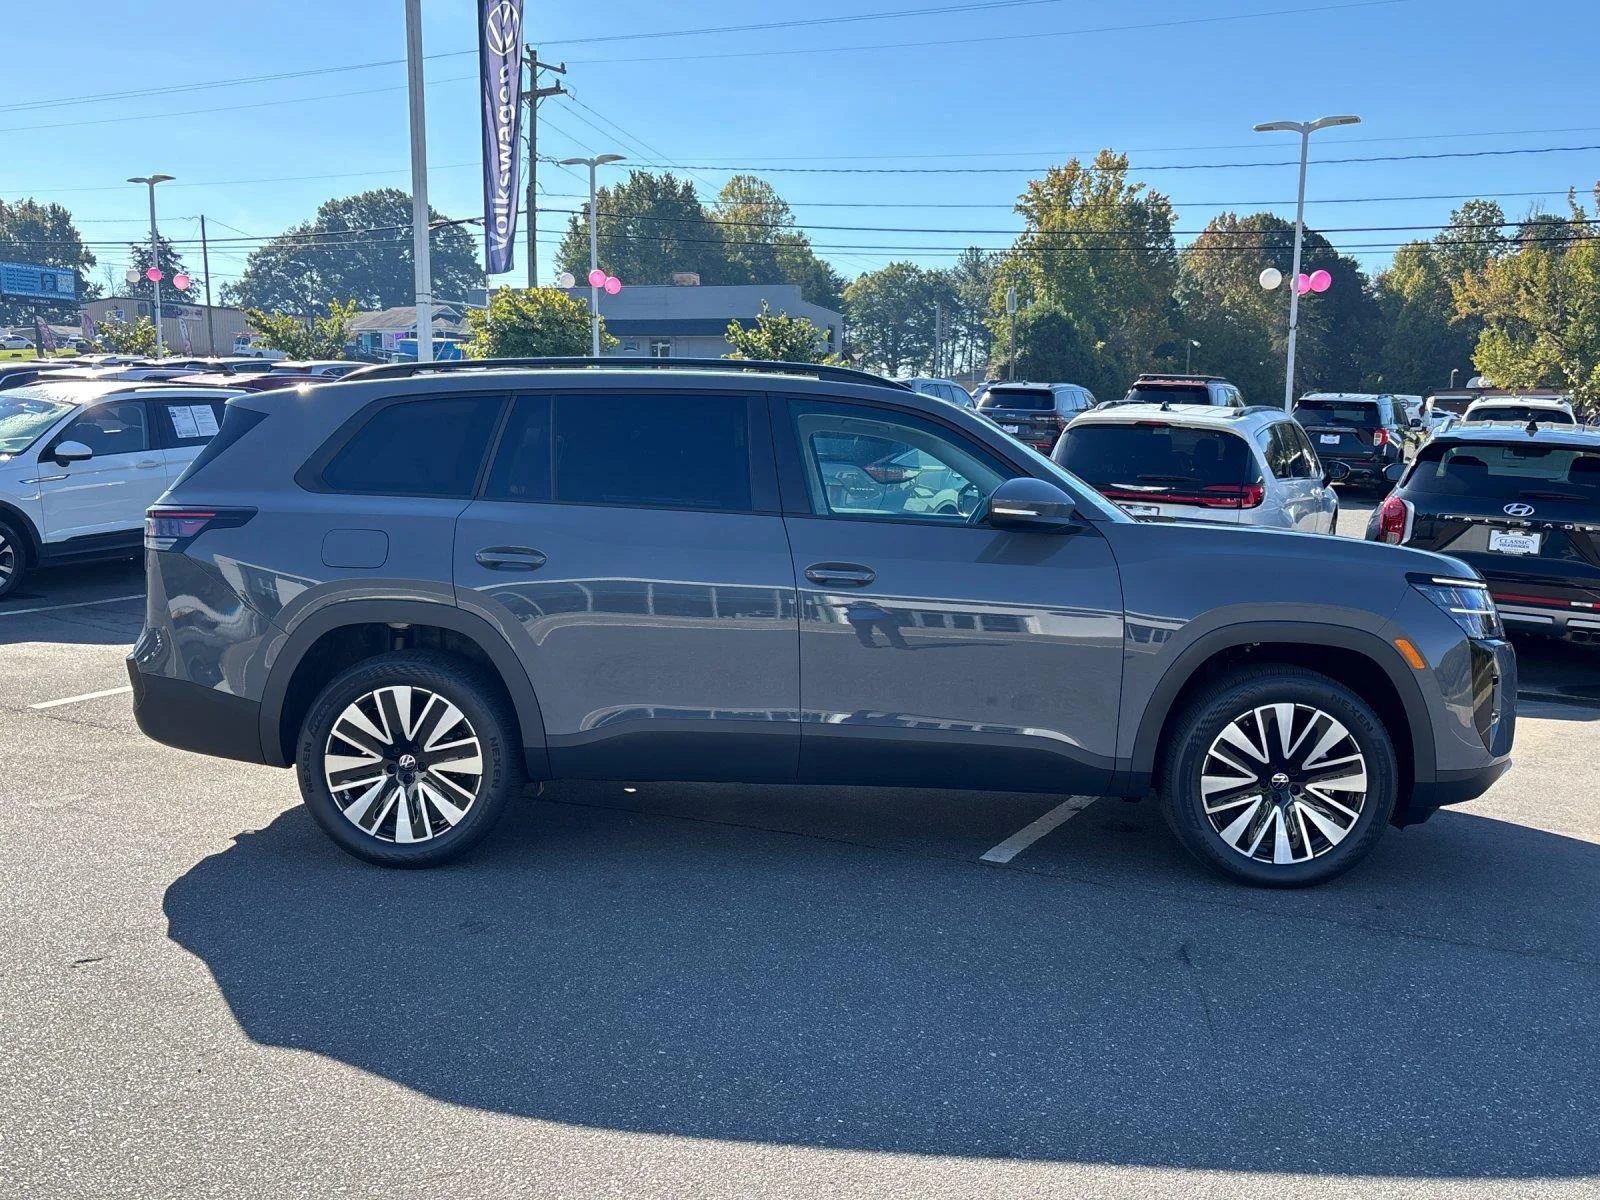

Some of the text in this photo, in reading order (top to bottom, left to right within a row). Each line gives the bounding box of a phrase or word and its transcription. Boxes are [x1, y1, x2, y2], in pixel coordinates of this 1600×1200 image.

[490, 63, 516, 251] Volkswagen
[1500, 538, 1530, 546] CLASSIC
[1331, 694, 1374, 733] NEXEN
[303, 741, 314, 794] NEXEN
[489, 737, 501, 789] NEXEN
